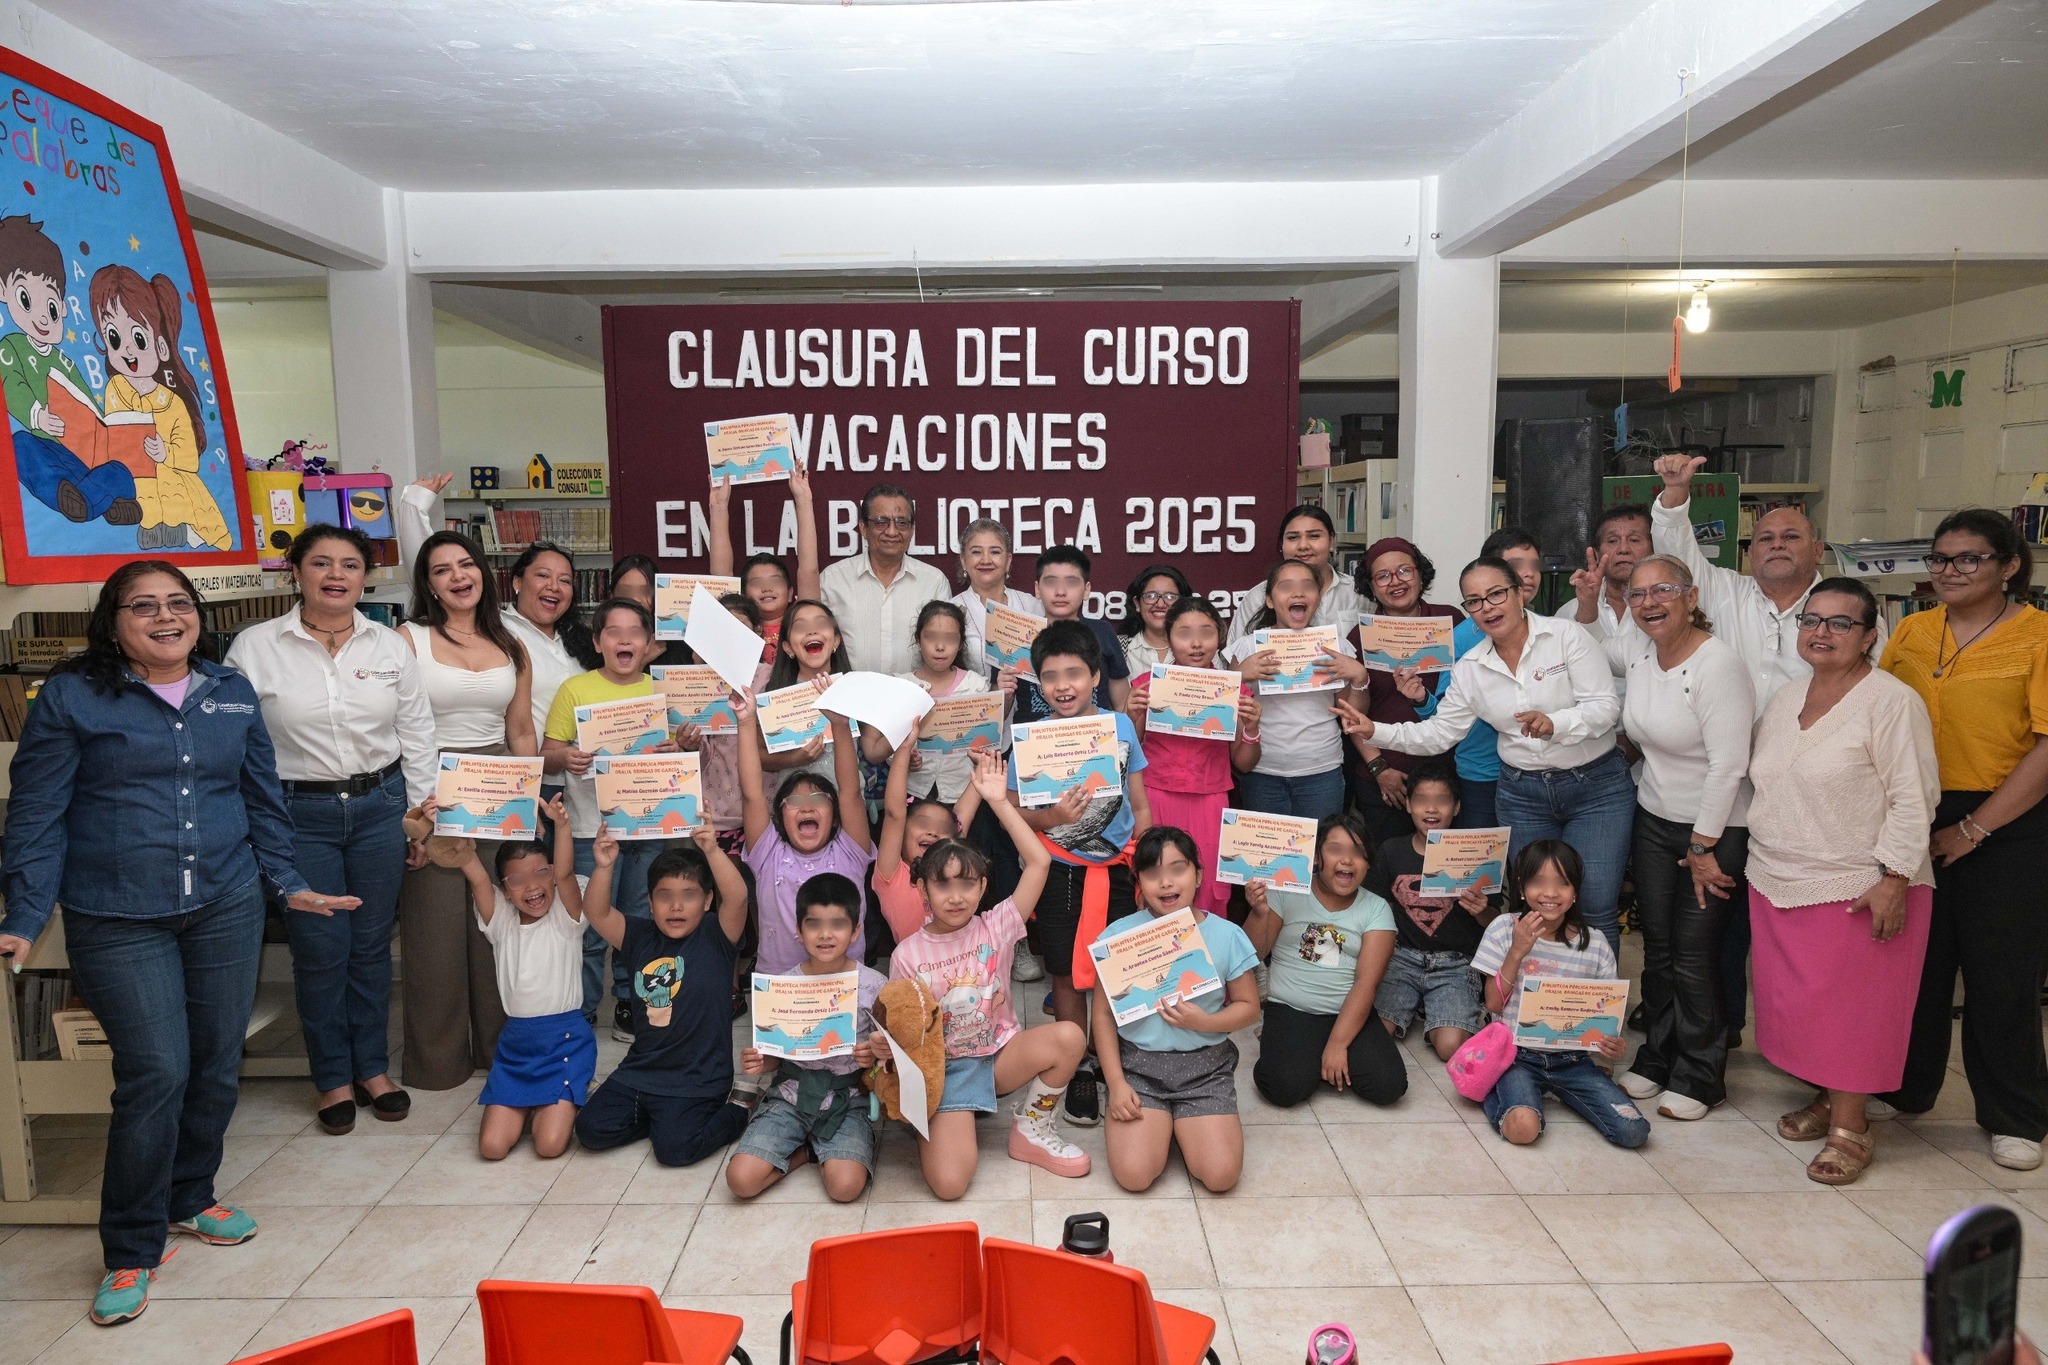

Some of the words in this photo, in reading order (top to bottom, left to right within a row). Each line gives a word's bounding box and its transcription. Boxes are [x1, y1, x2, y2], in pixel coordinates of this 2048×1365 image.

[106, 126, 136, 167] de
[73, 260, 85, 282] A
[68, 296, 87, 325] R
[183, 346, 198, 365] T
[668, 328, 929, 389] CLAUSURA
[956, 326, 1056, 387] DEL
[1083, 326, 1249, 386] CURSO
[84, 355, 104, 390] B
[163, 370, 177, 388] E
[203, 379, 215, 405] S
[1930, 369, 1965, 409] M
[789, 413, 1107, 472] VACACIONES
[557, 465, 592, 480] COLECCIÓN
[593, 468, 602, 480] DE
[557, 482, 588, 494] CONSULTA
[1613, 485, 1631, 499] DE
[656, 500, 711, 558] EN
[744, 499, 798, 557] LA
[1126, 496, 1256, 553] 2025
[225, 572, 262, 589] MATEMÁTICAS
[1082, 591, 1127, 620] 08
[17, 640, 27, 648] SE
[29, 640, 64, 648] SUPLICA
[18, 649, 29, 657] No
[30, 649, 65, 657] introducir
[1110, 937, 1136, 950] BIBLIOTECA
[1136, 929, 1158, 939] PÚBLICA
[1155, 919, 1180, 932] MUNICIPAL
[1116, 945, 1134, 954] ORALIA
[1134, 939, 1154, 948] BRINGAS
[918, 944, 984, 974] Cinnamoroll
[1128, 959, 1148, 970] Arantxa
[1148, 954, 1163, 963] Cueto
[1162, 946, 1182, 957] Sánchez
